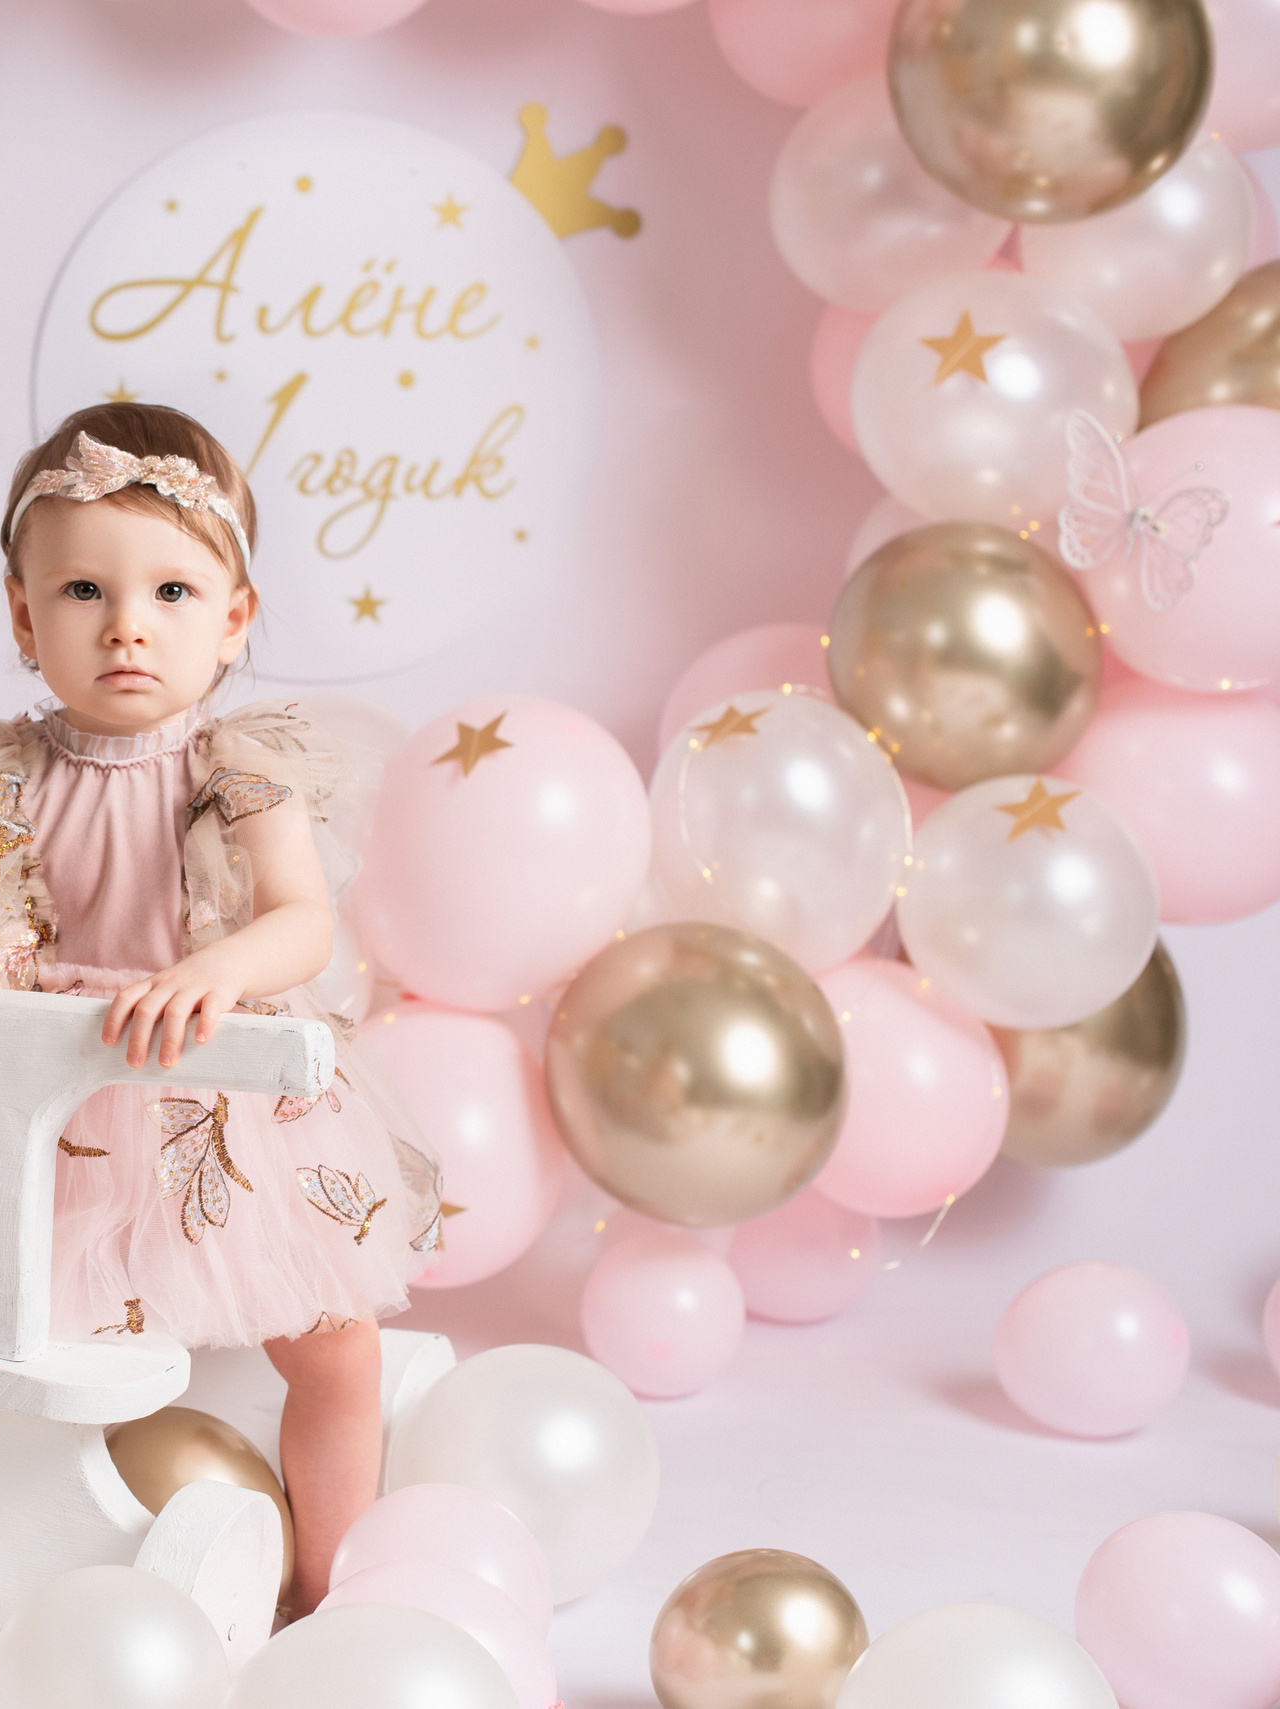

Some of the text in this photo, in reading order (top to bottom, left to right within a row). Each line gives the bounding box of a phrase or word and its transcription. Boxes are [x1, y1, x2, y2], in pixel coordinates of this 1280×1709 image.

[89, 205, 501, 343] Алёне
[242, 372, 525, 560] 1 годик
